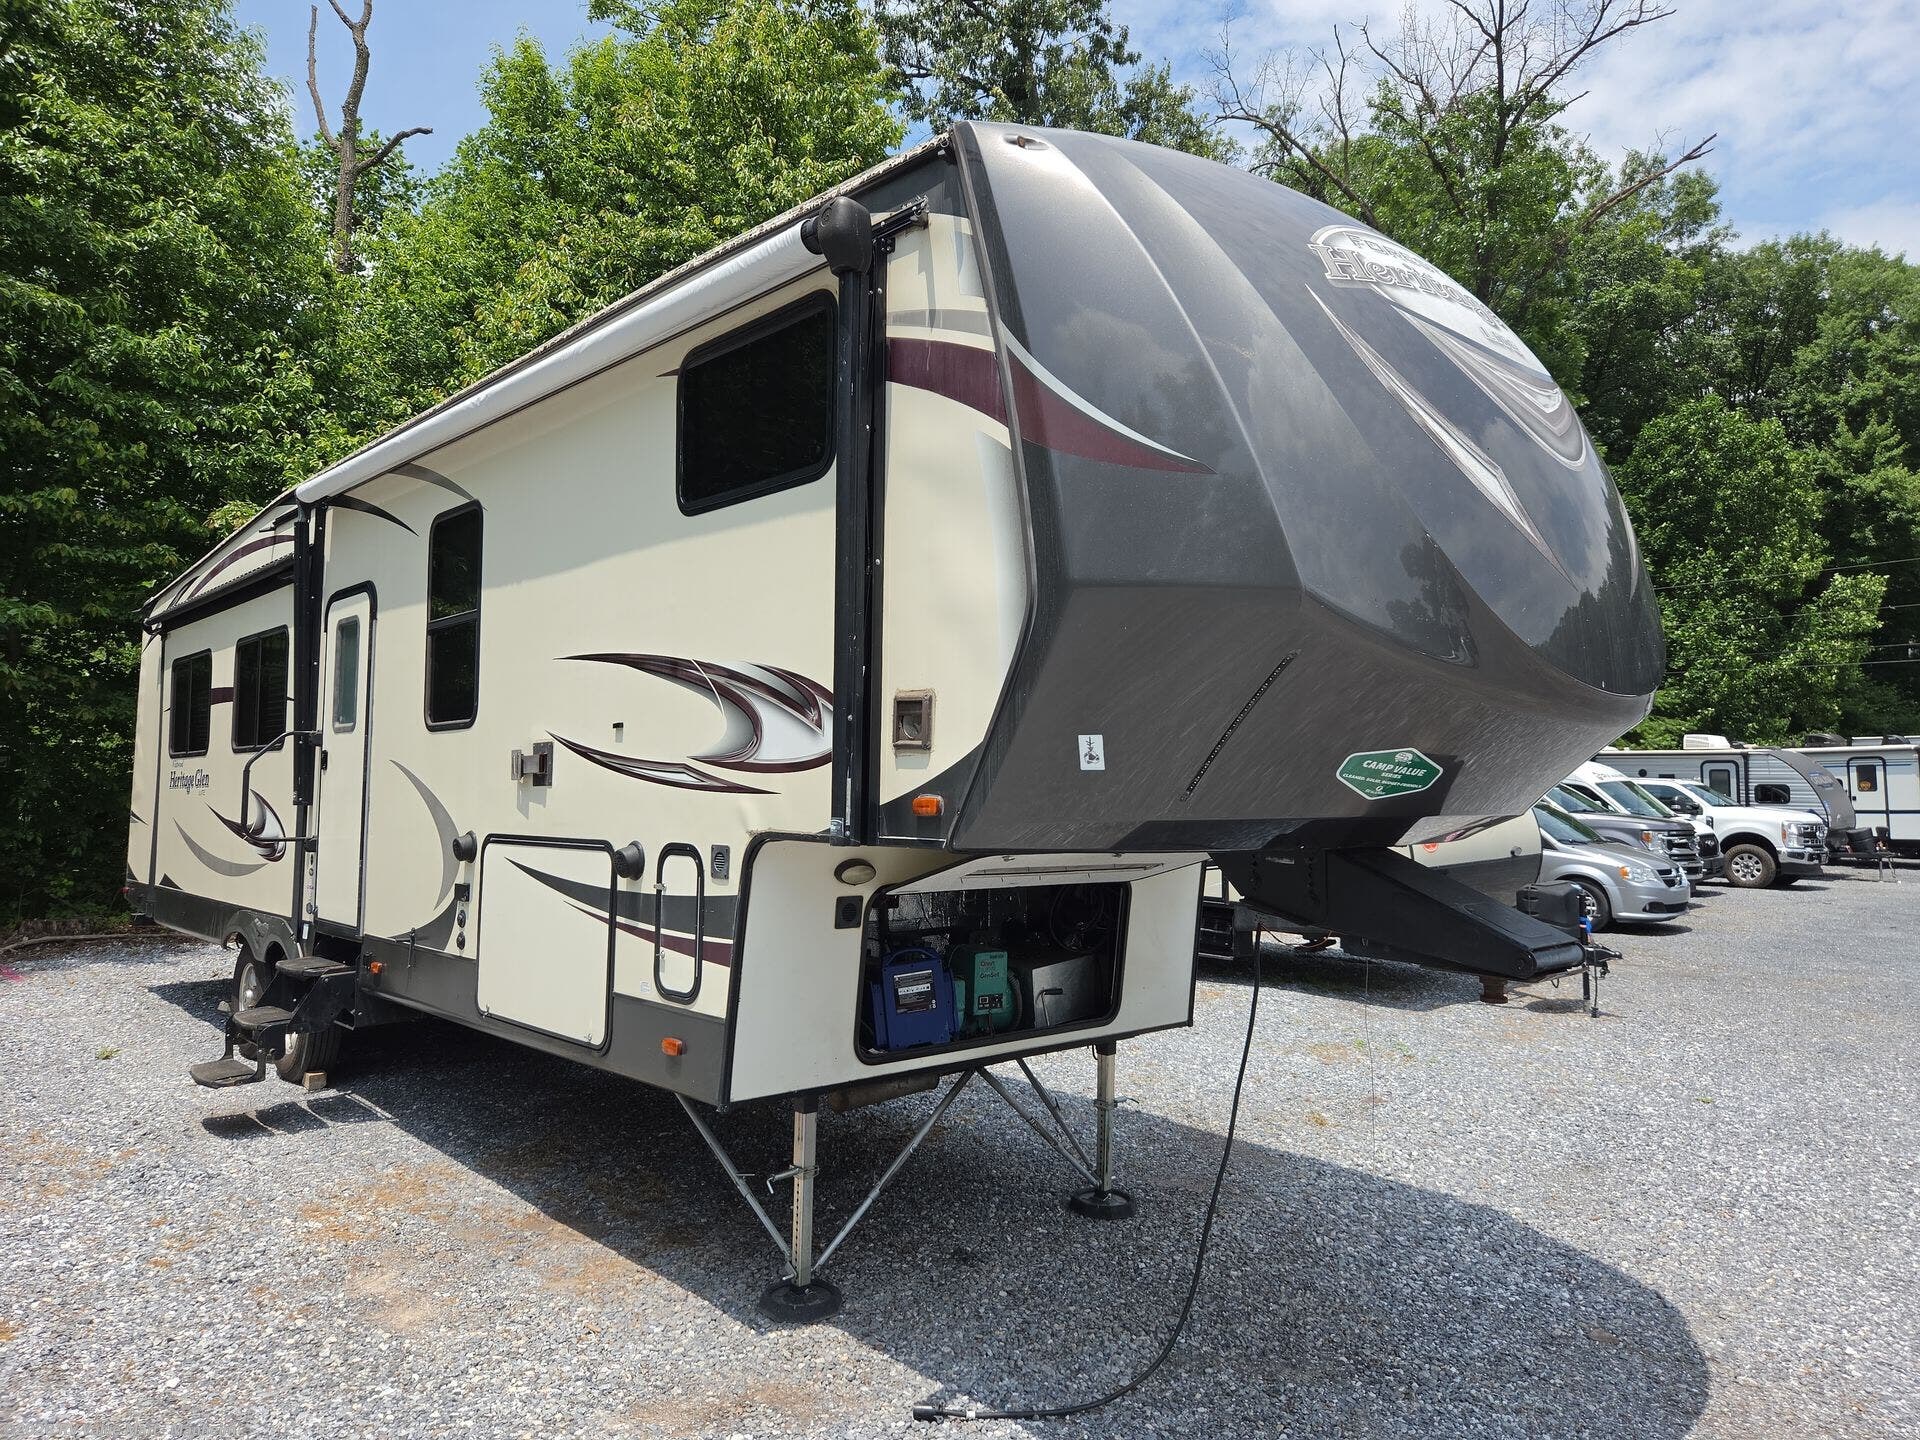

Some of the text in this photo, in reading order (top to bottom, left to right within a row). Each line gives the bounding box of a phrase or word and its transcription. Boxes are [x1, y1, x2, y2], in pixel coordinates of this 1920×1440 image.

[1362, 760, 1427, 776] CAMP VALUE
[169, 769, 209, 795] Heritage Glen
